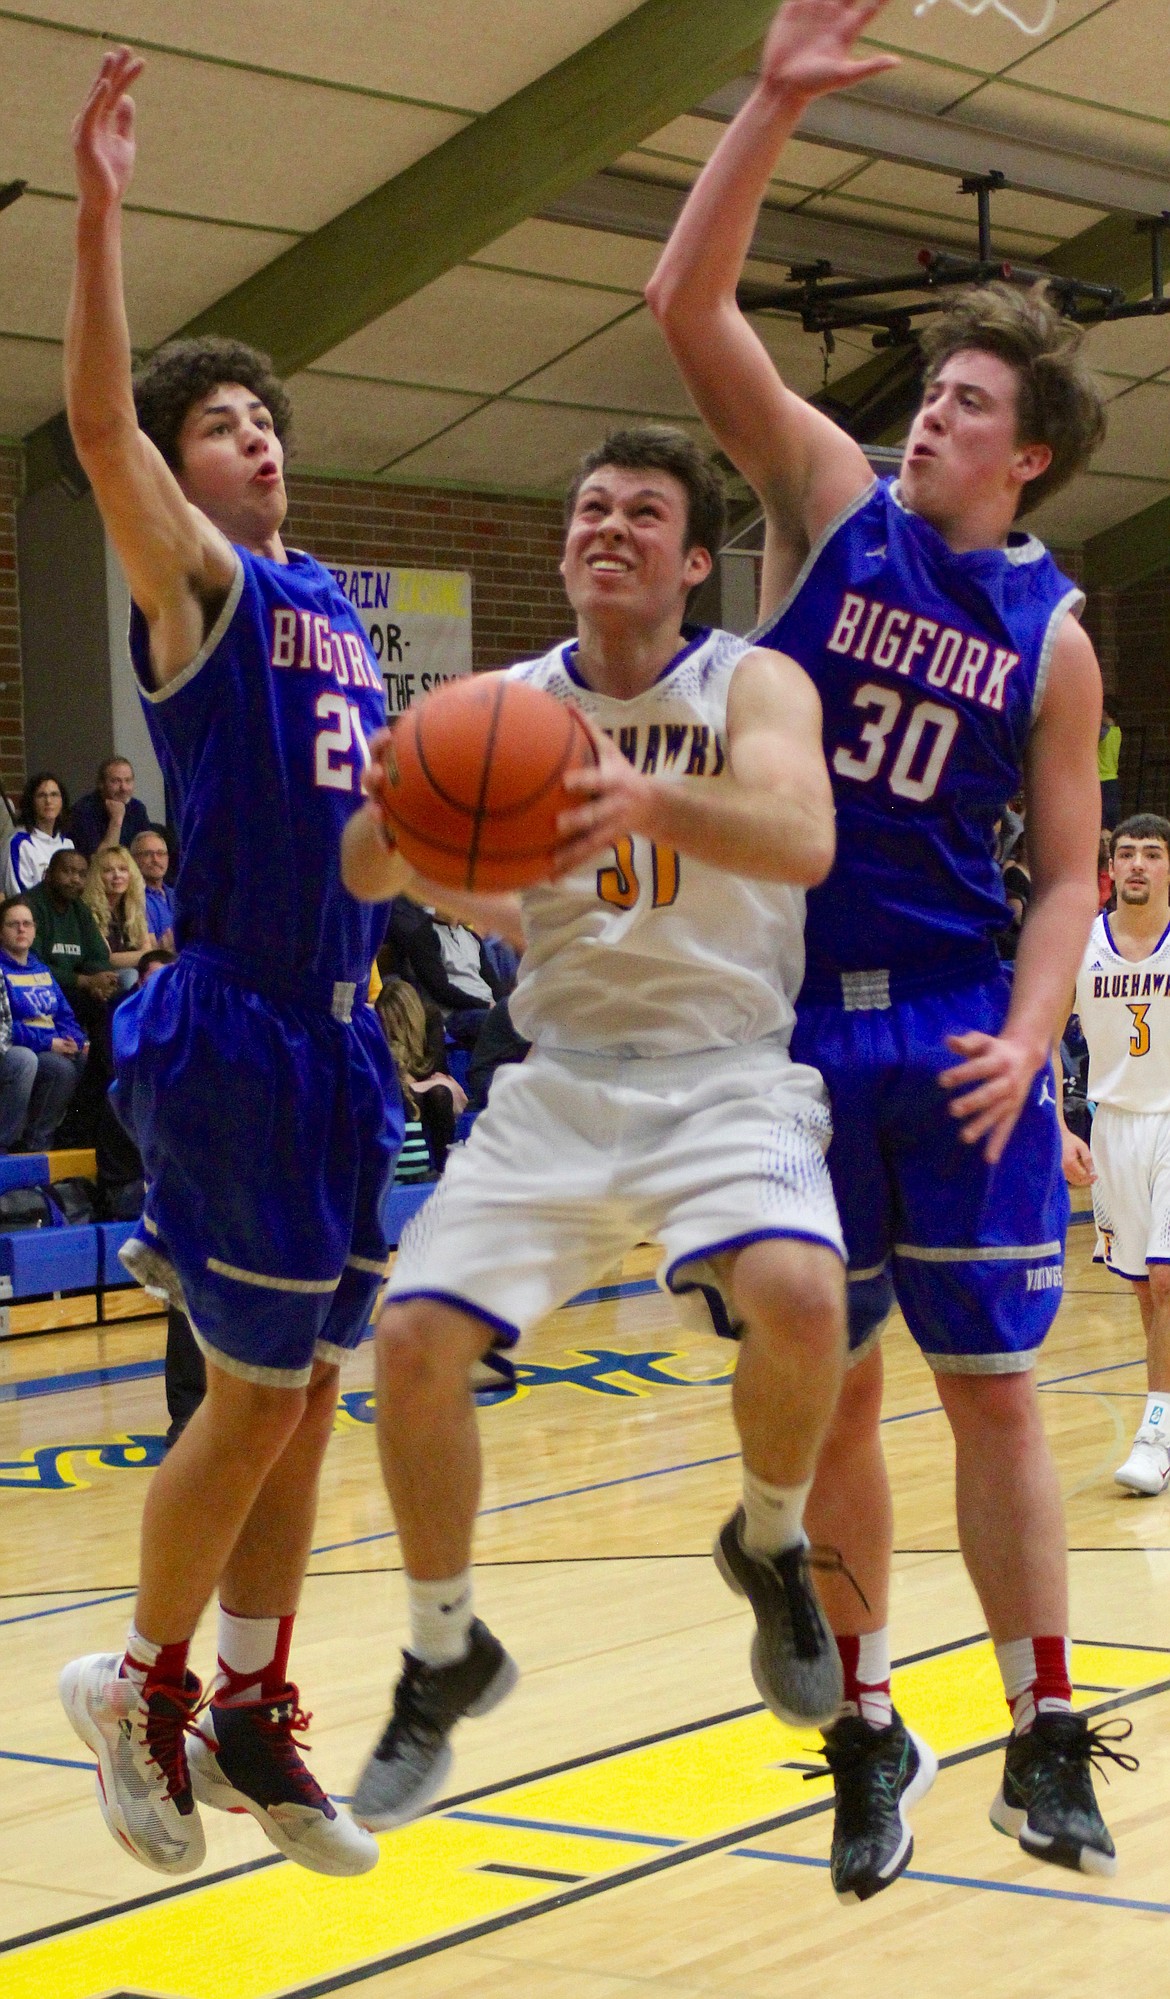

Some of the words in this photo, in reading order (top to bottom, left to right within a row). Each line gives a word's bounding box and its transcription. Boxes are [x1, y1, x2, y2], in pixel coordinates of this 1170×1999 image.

[826, 592, 1020, 713] BIGFORK
[832, 682, 960, 804] 30
[1125, 1002, 1152, 1058] 3
